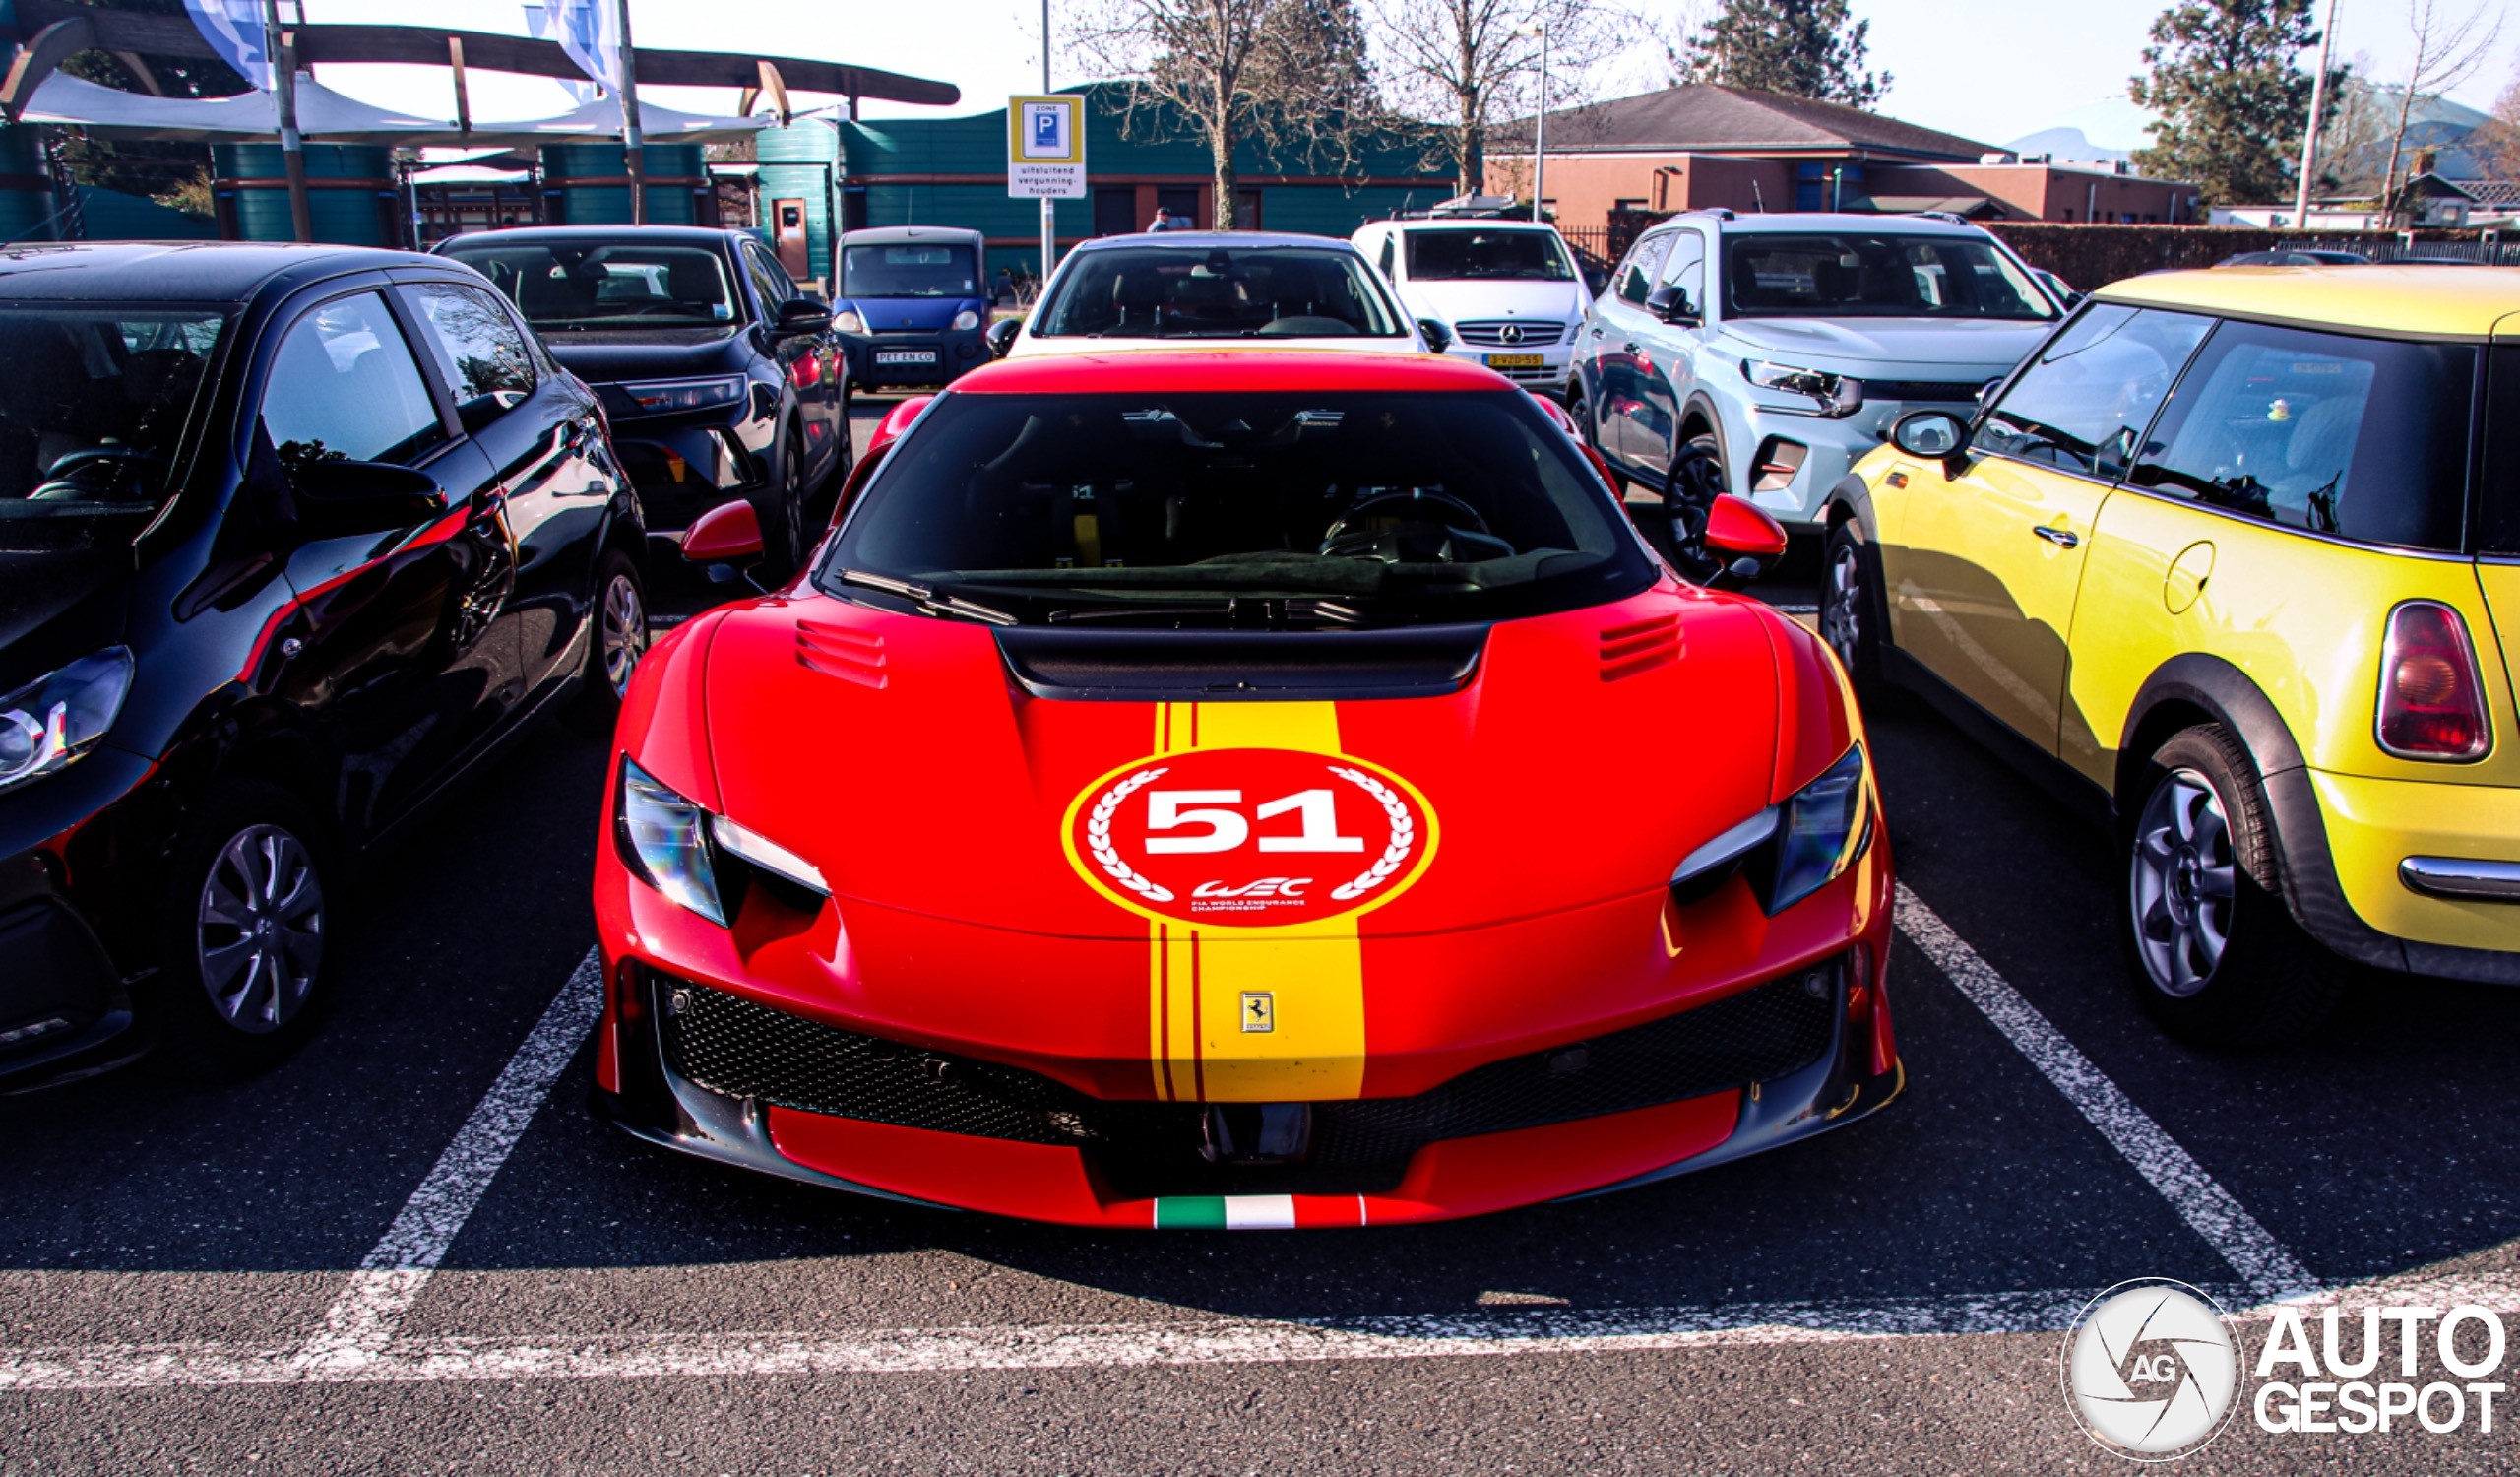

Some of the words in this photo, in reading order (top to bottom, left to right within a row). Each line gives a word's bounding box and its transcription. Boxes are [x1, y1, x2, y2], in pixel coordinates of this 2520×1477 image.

[1040, 116, 1053, 134] P
[1019, 177, 1077, 186] vergunning-
[1029, 186, 1067, 195] houders
[902, 353, 915, 361] EN
[918, 353, 932, 361] CO
[1145, 789, 1365, 855] 51
[1191, 876, 1314, 897] WEC
